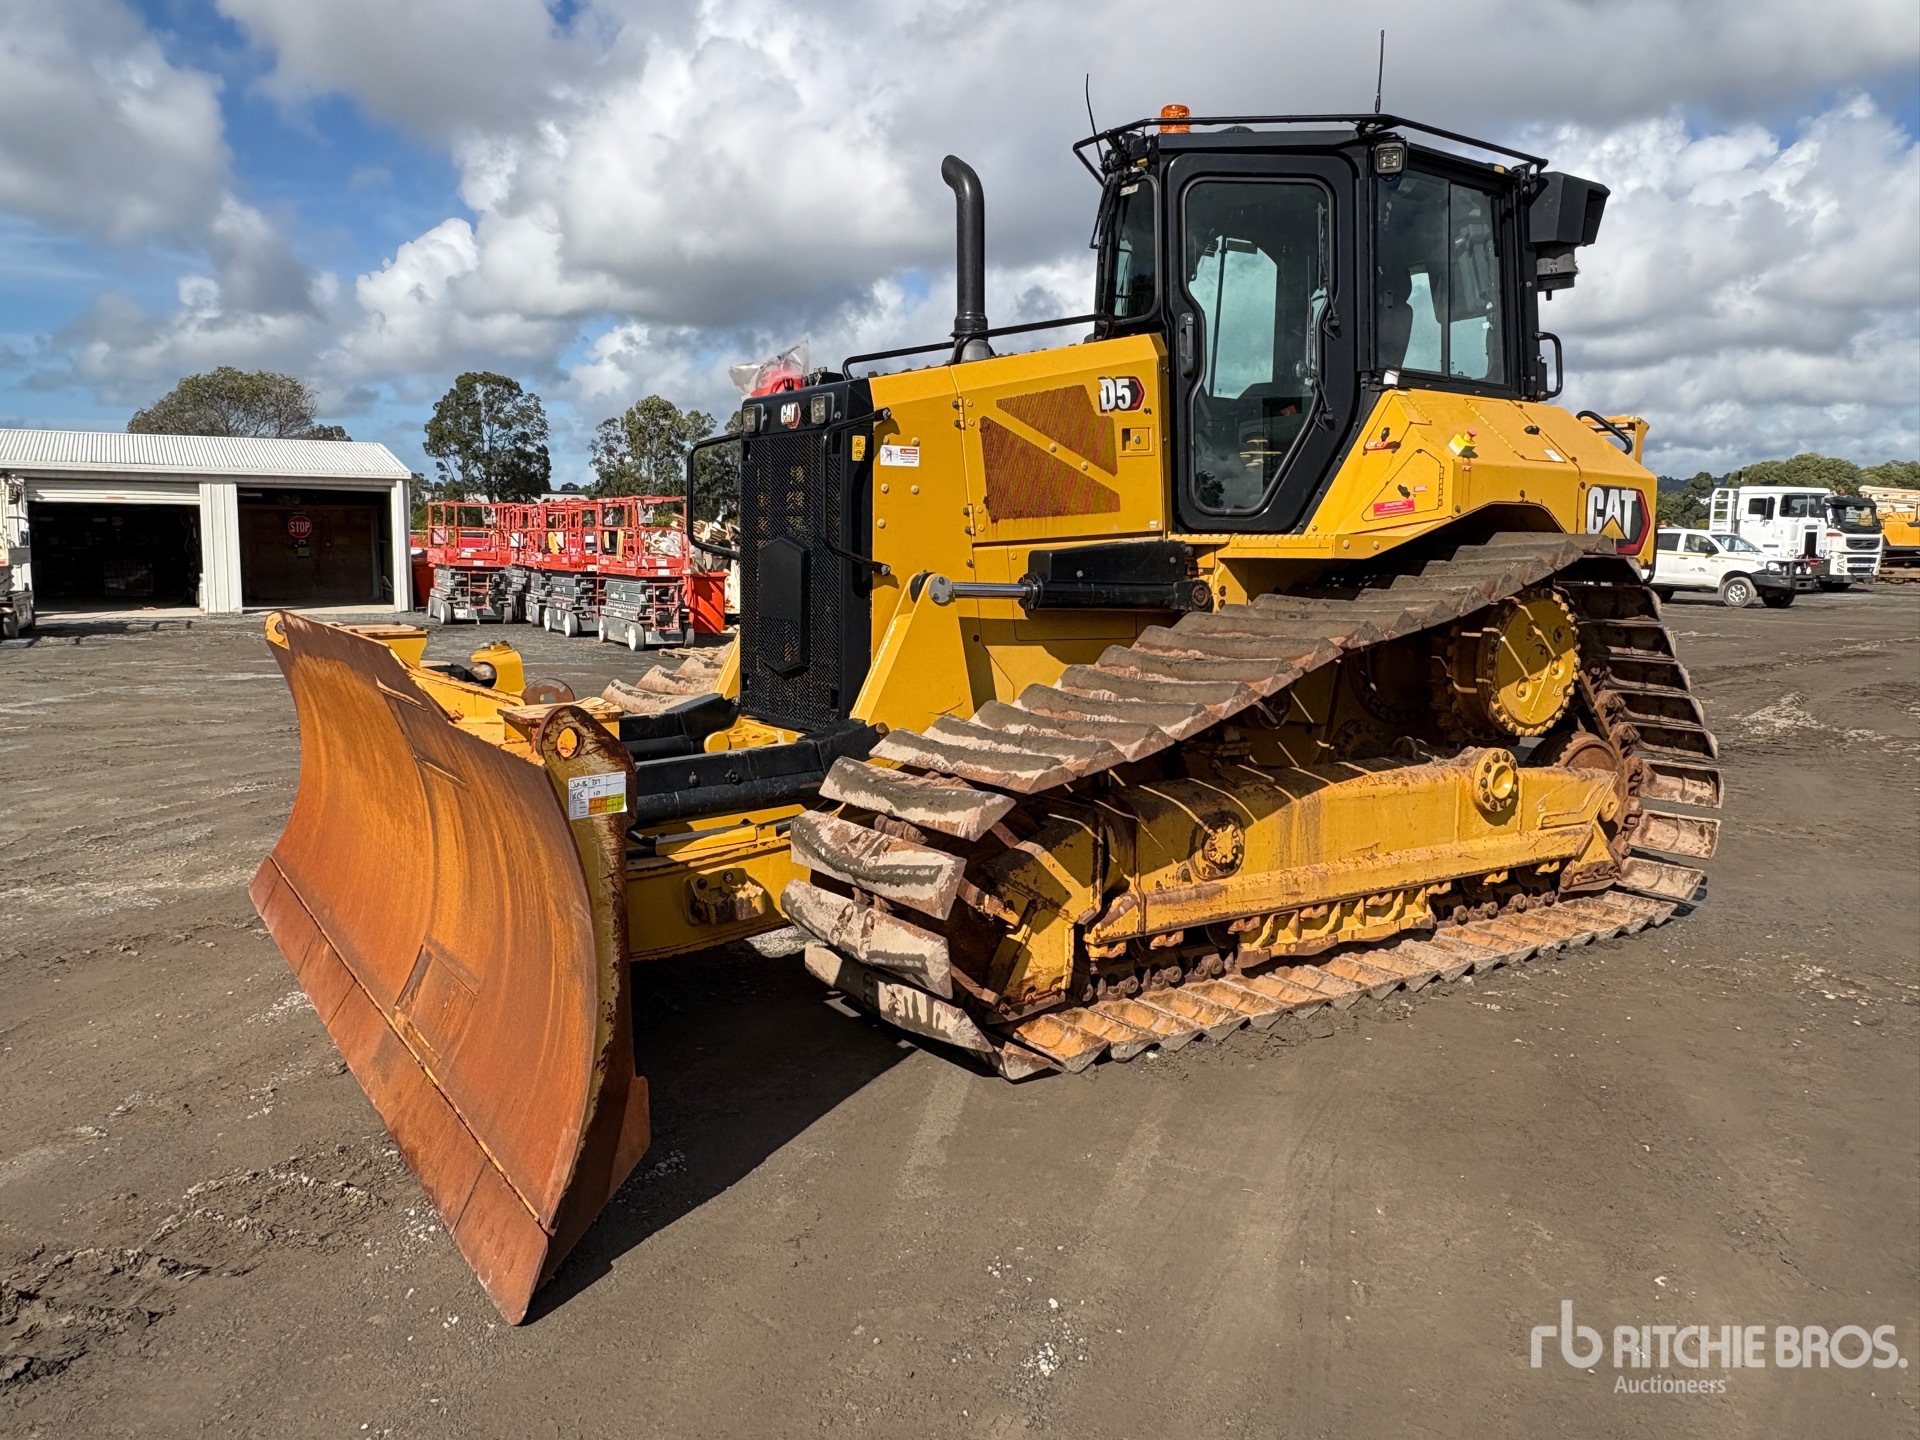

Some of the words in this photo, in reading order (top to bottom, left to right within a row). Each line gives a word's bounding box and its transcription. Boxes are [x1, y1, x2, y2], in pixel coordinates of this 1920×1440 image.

[1099, 377, 1132, 411] D5
[780, 403, 796, 425] CAT
[290, 521, 310, 533] STOP
[1587, 487, 1637, 540] CAT
